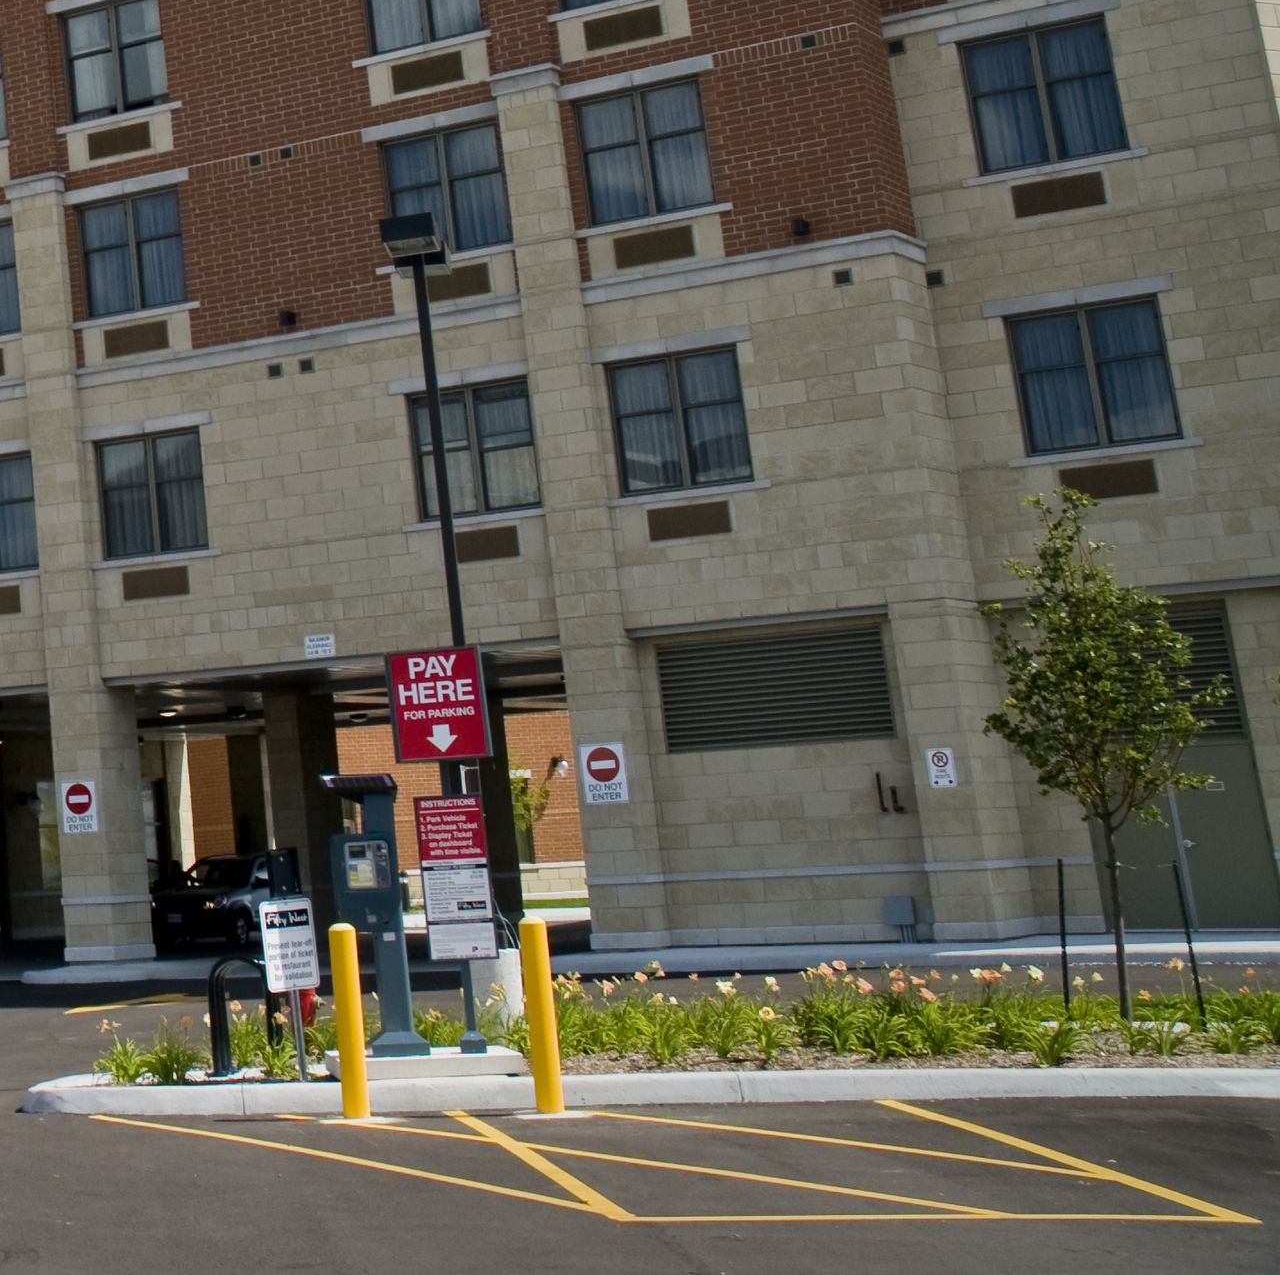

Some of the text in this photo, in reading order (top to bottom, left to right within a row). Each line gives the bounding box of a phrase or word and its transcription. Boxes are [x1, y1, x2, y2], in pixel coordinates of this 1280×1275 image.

[407, 654, 456, 680] PAY
[398, 678, 475, 706] HERE
[403, 706, 475, 721] FOR PARKING
[588, 781, 622, 793] DO NOT
[592, 791, 622, 802] ENTER
[420, 798, 477, 808] INSTRUCTIONS
[66, 815, 93, 824] DO NOT
[68, 823, 93, 832] ENTER
[428, 832, 451, 840] Display
